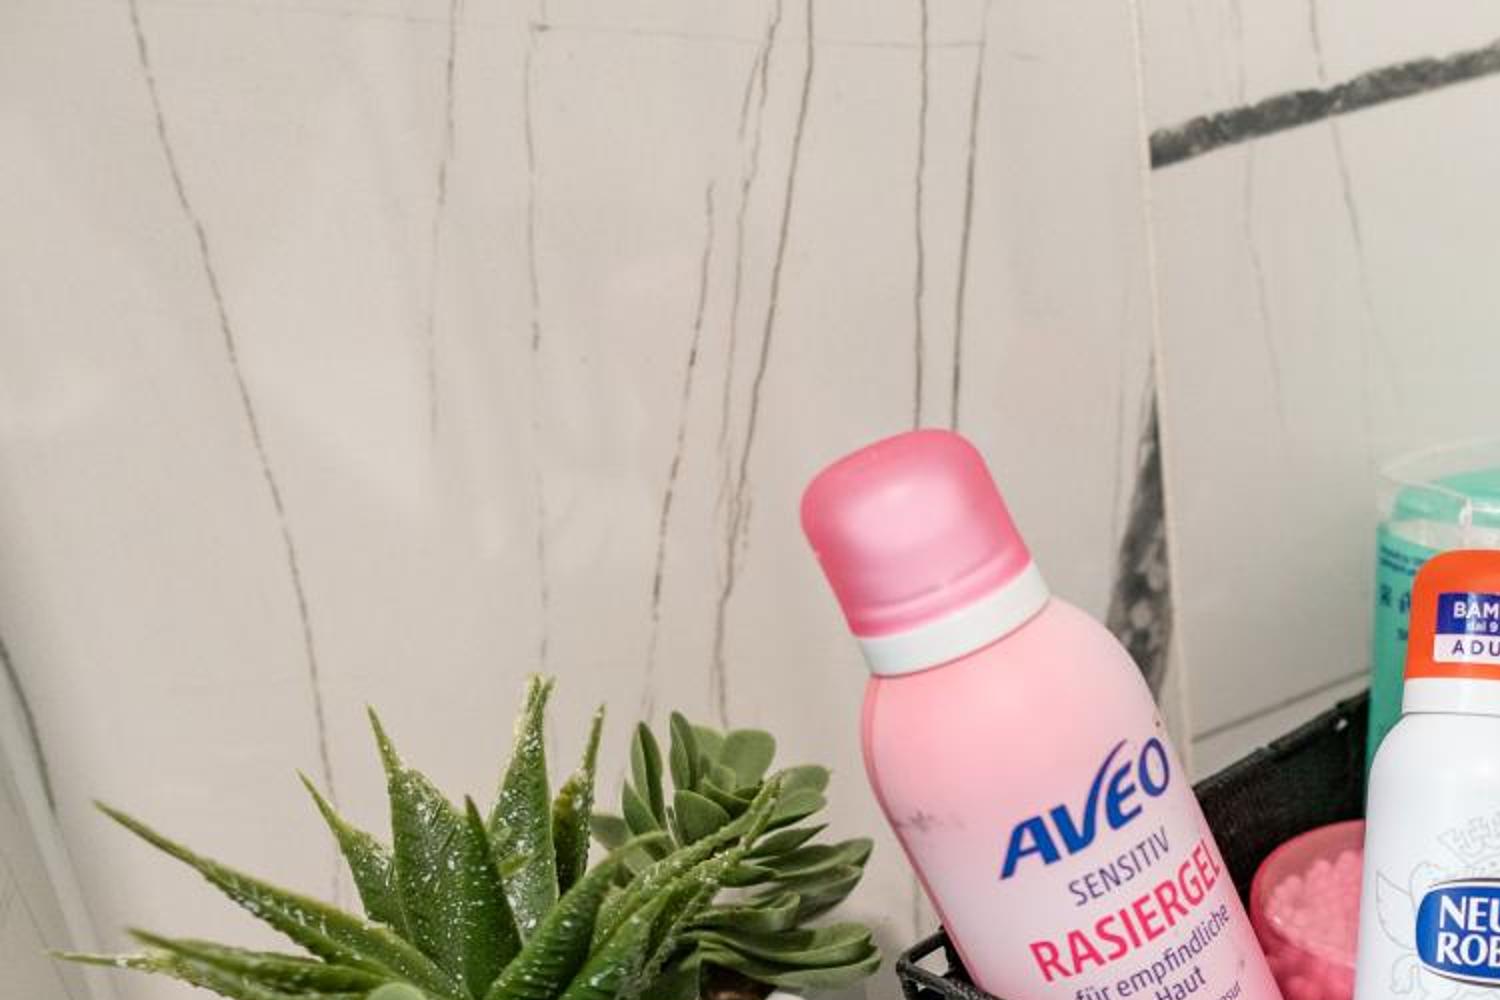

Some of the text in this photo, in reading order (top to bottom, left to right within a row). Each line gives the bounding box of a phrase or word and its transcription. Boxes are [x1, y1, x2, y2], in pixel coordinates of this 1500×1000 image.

[1489, 623, 1499, 633] 9
[1000, 738, 1169, 880] AVEO
[1029, 840, 1220, 983] RASIERGEL
[1068, 826, 1169, 907] SENSITIV
[1116, 903, 1230, 997] empfindliche
